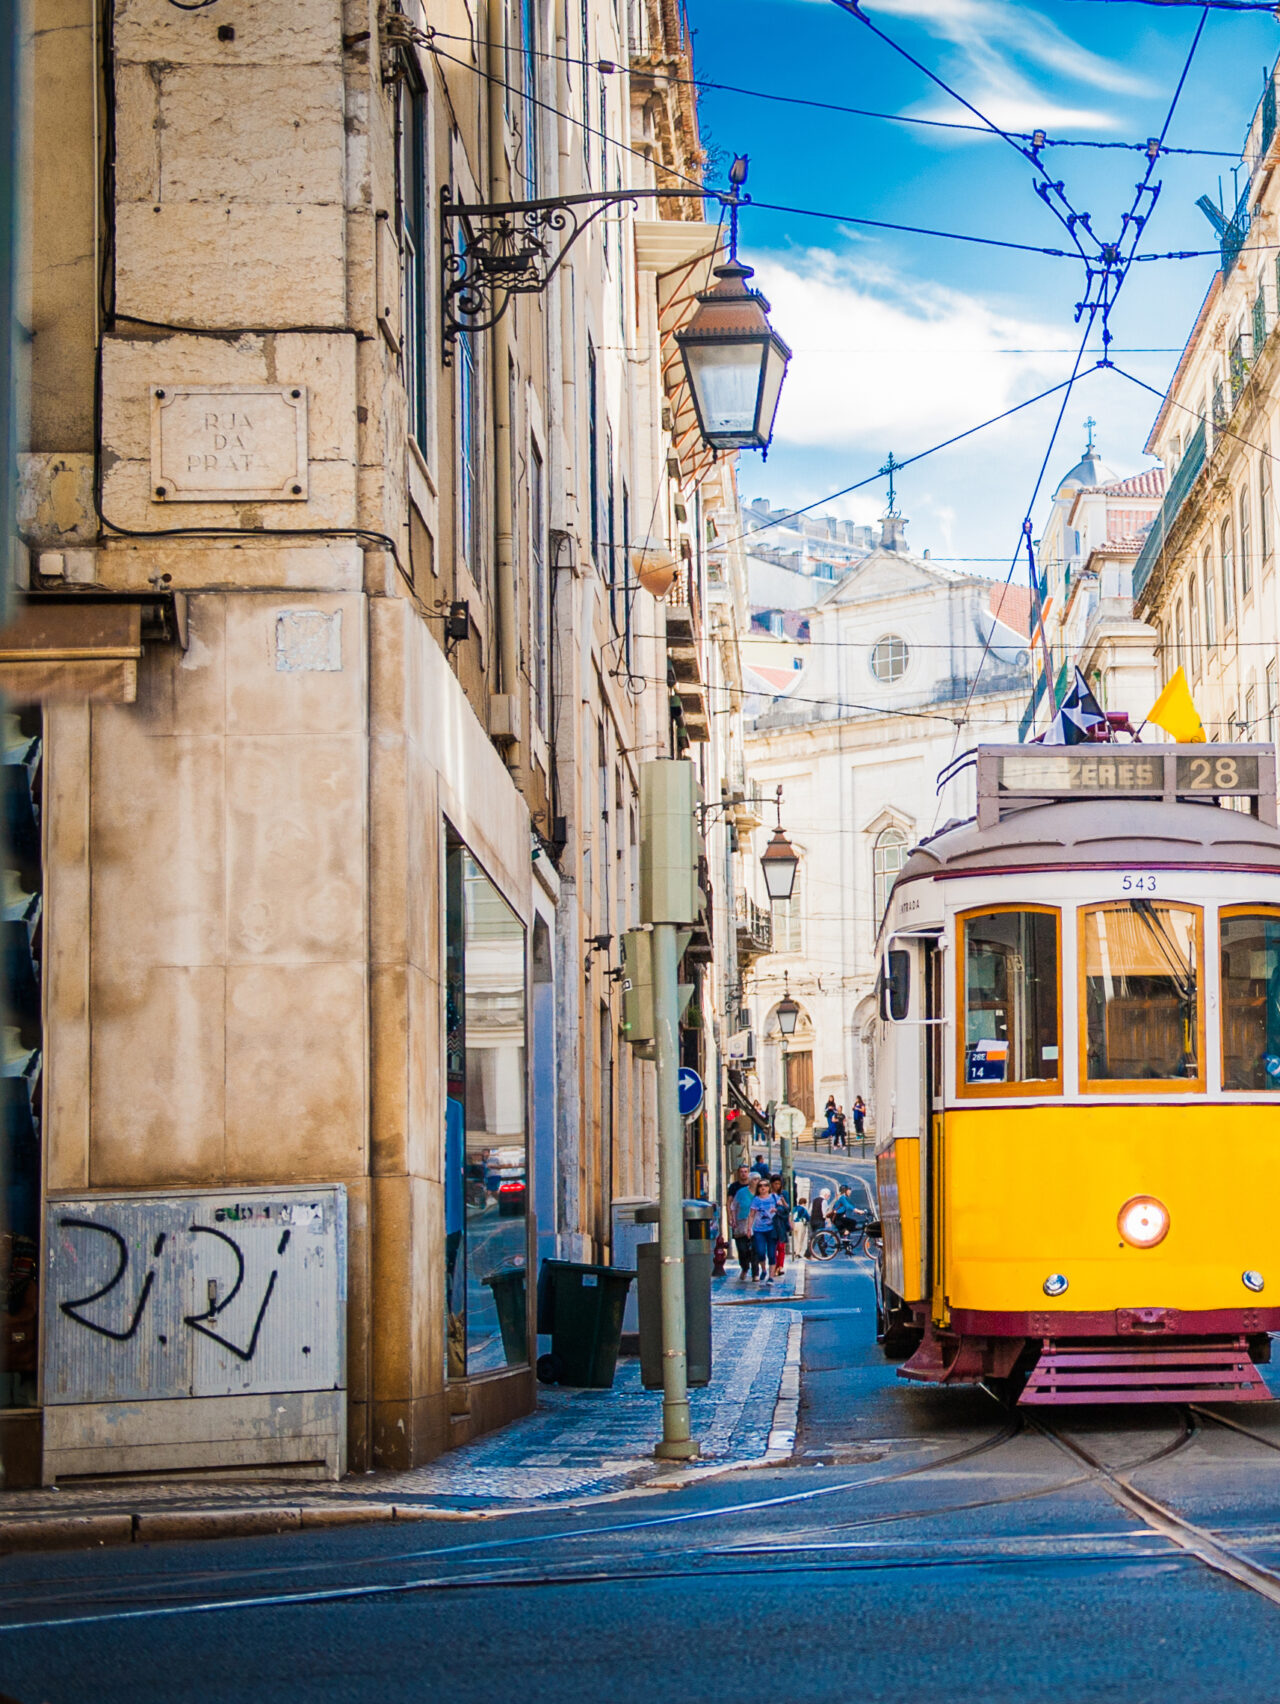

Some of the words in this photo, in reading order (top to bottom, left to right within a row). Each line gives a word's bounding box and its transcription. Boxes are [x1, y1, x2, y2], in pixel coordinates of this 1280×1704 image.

[204, 412, 254, 431] RUA
[213, 434, 246, 451] DA
[187, 454, 270, 473] PRATA
[1009, 763, 1154, 786] ZERES
[1189, 757, 1240, 789] 28
[1122, 875, 1157, 891] 543
[971, 1067, 984, 1078] 14
